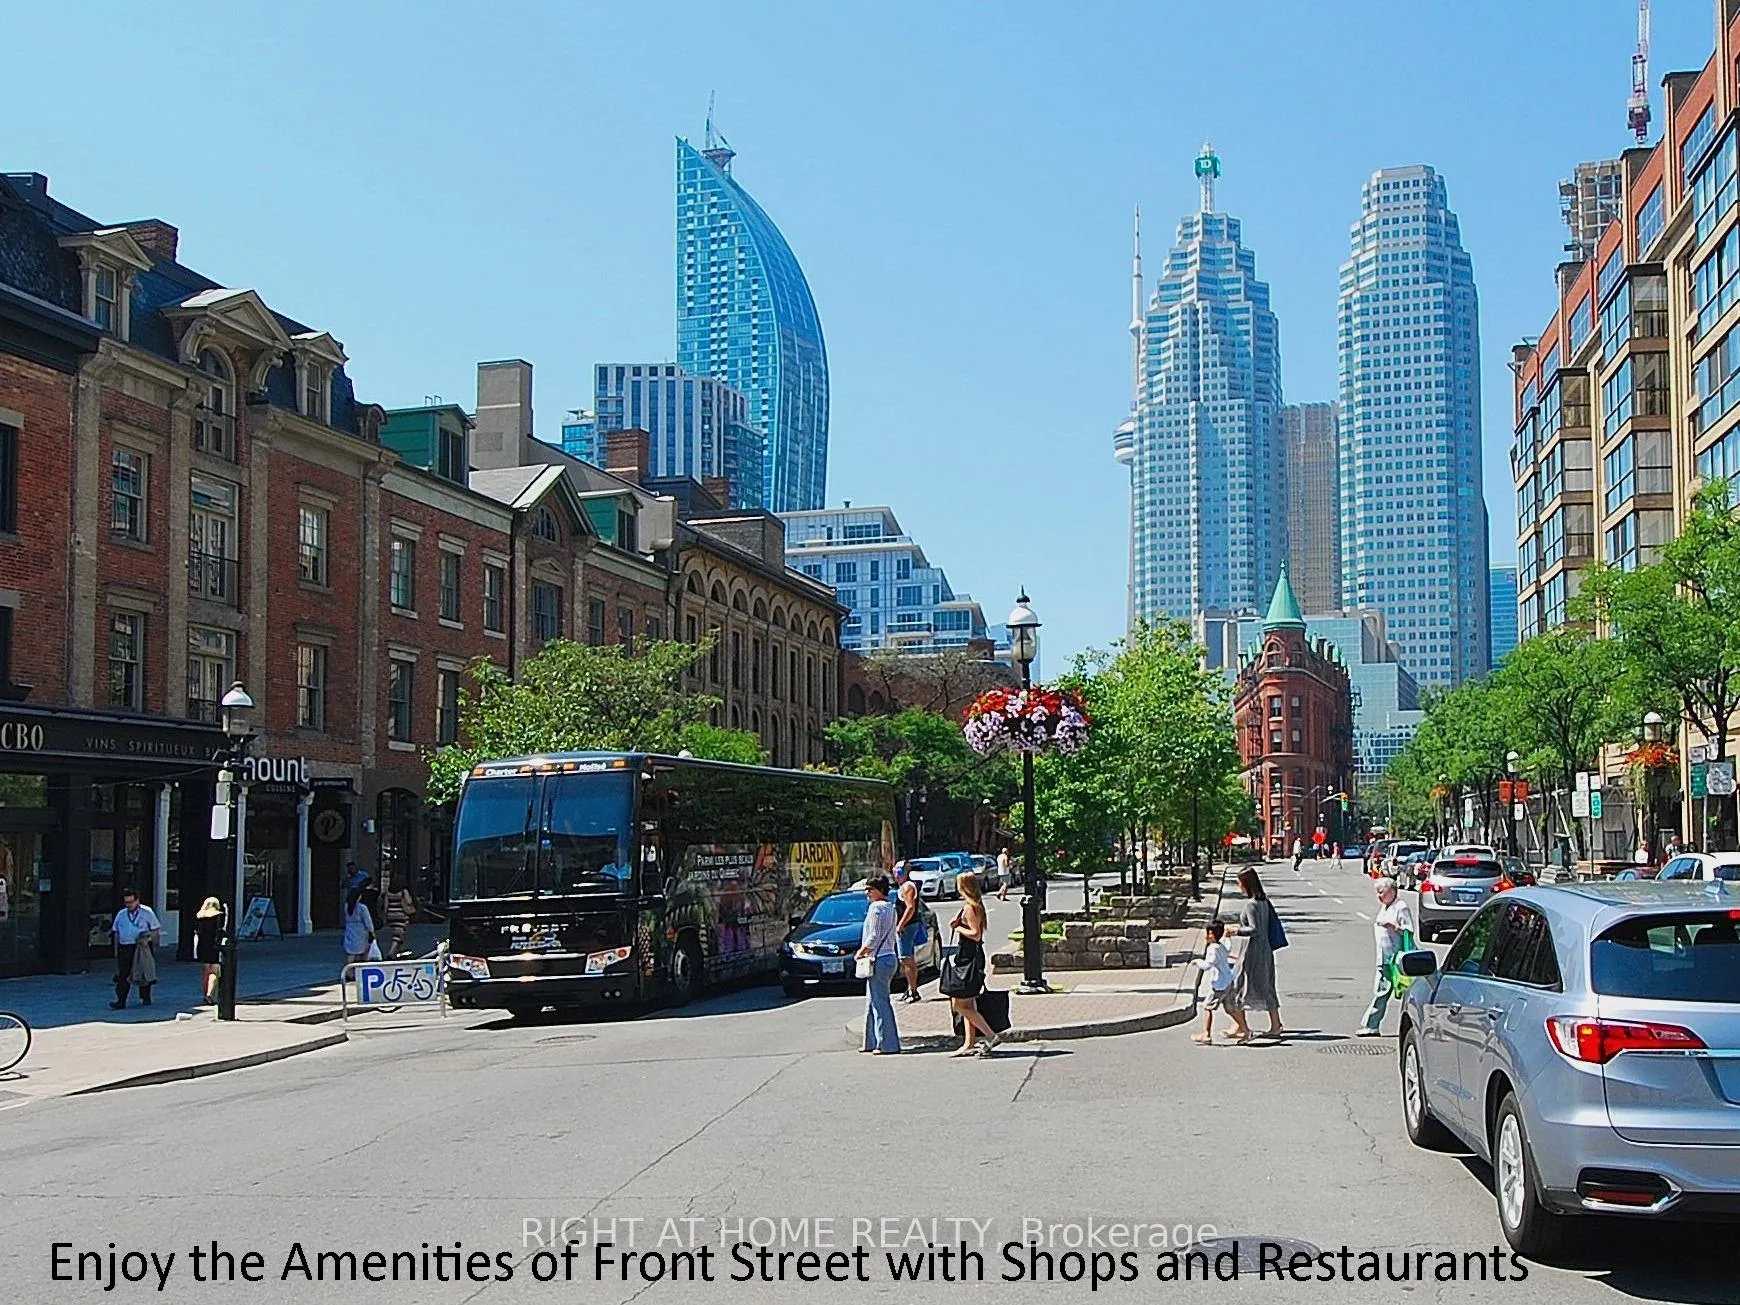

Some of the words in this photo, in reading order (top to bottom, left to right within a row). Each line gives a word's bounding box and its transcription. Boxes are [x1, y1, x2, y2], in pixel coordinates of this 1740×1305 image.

[86, 737, 116, 750] VINS
[128, 740, 195, 756] SPIRITUEUX
[795, 843, 834, 863] JARDIN
[361, 968, 385, 1004] P
